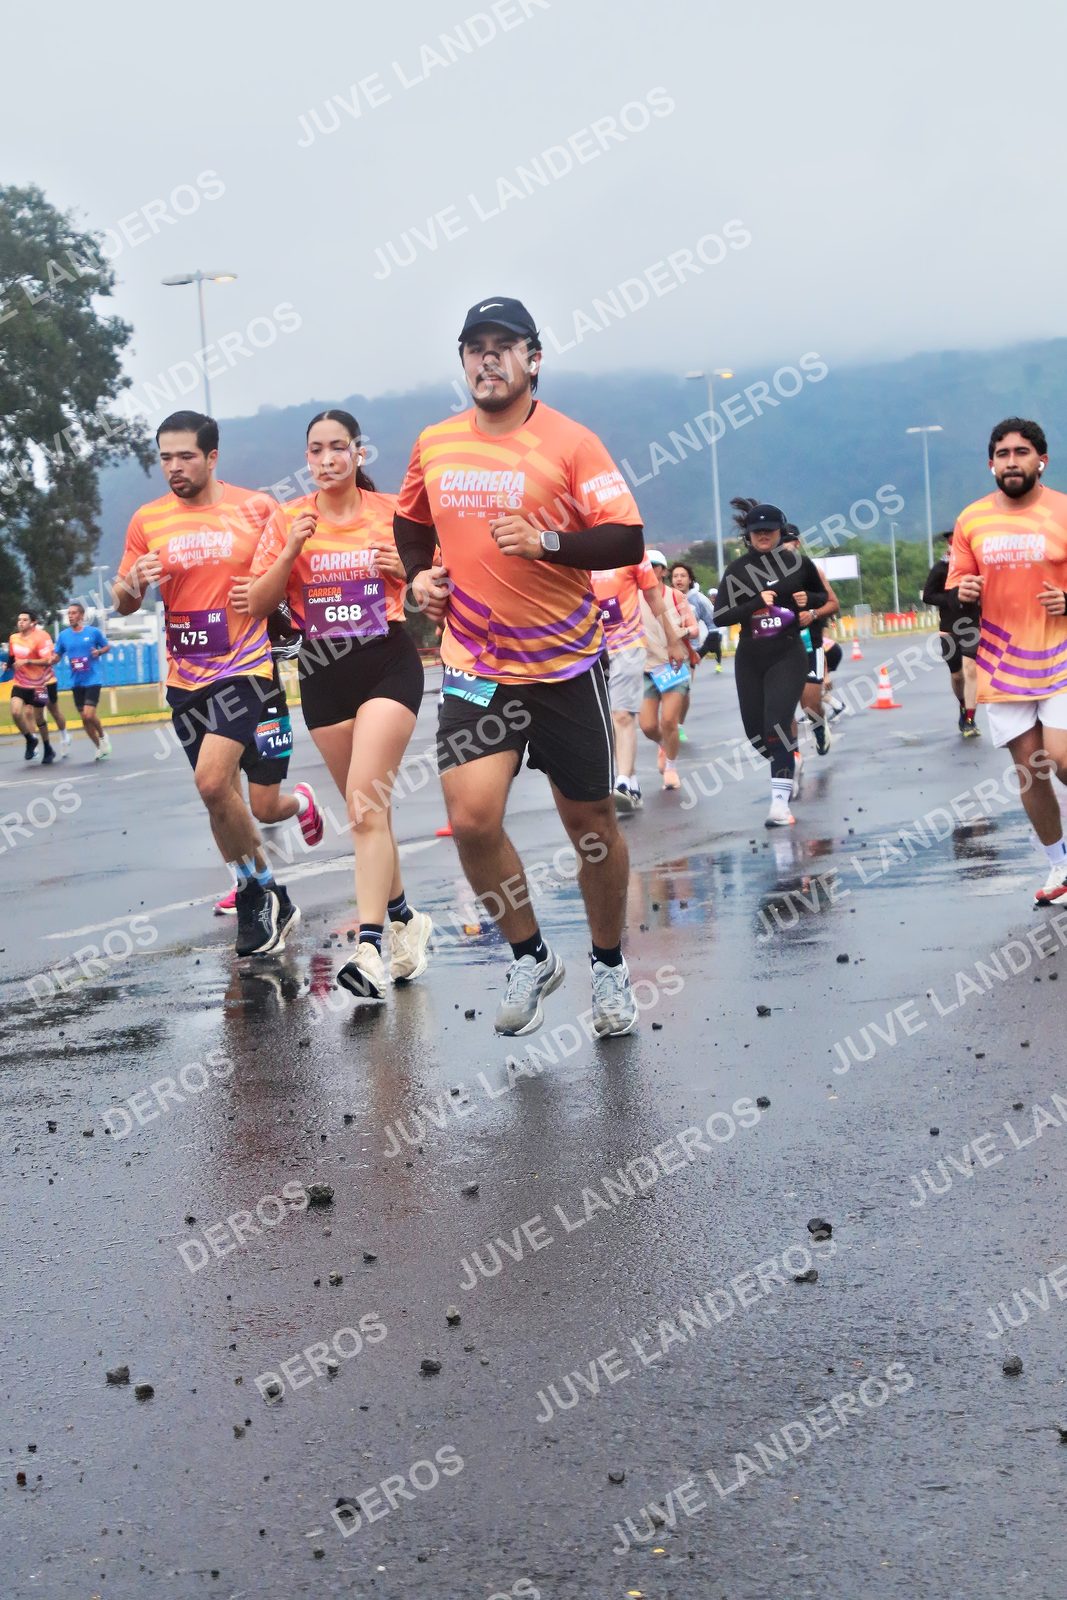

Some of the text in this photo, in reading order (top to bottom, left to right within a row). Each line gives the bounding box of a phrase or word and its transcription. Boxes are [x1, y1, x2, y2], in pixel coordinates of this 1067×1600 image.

[440, 469, 525, 492] CARRERA
[168, 531, 234, 553] CARRERA
[983, 534, 1046, 553] CARRERA
[307, 587, 342, 598] CARRERA
[363, 584, 379, 595] 15K
[207, 613, 221, 623] 15K
[325, 604, 362, 622] 688
[760, 617, 782, 629] 628
[181, 631, 208, 645] 475
